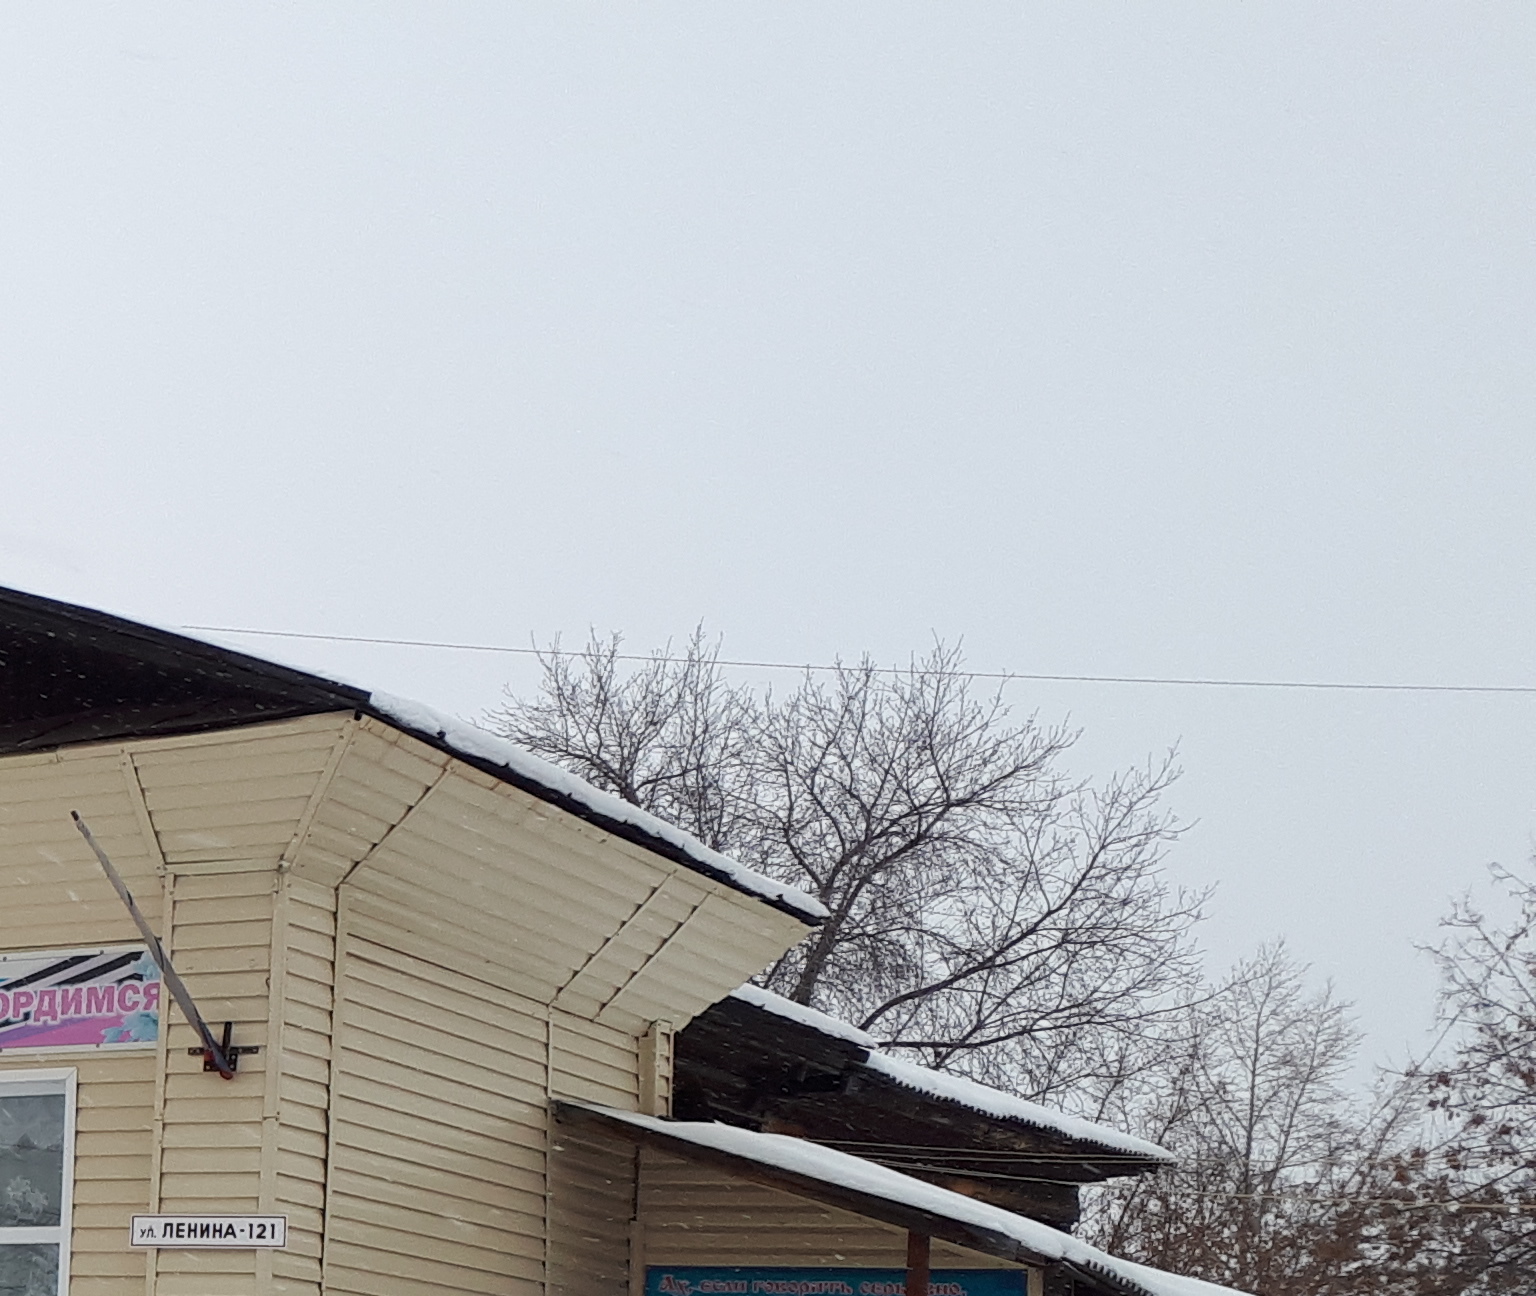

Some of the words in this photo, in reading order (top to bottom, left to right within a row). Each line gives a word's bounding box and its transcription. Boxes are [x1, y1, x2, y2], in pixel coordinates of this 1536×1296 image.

[140, 1225, 157, 1239] ул.
[162, 1223, 275, 1239] ЛЕНИНА-121
[699, 1279, 748, 1294] если
